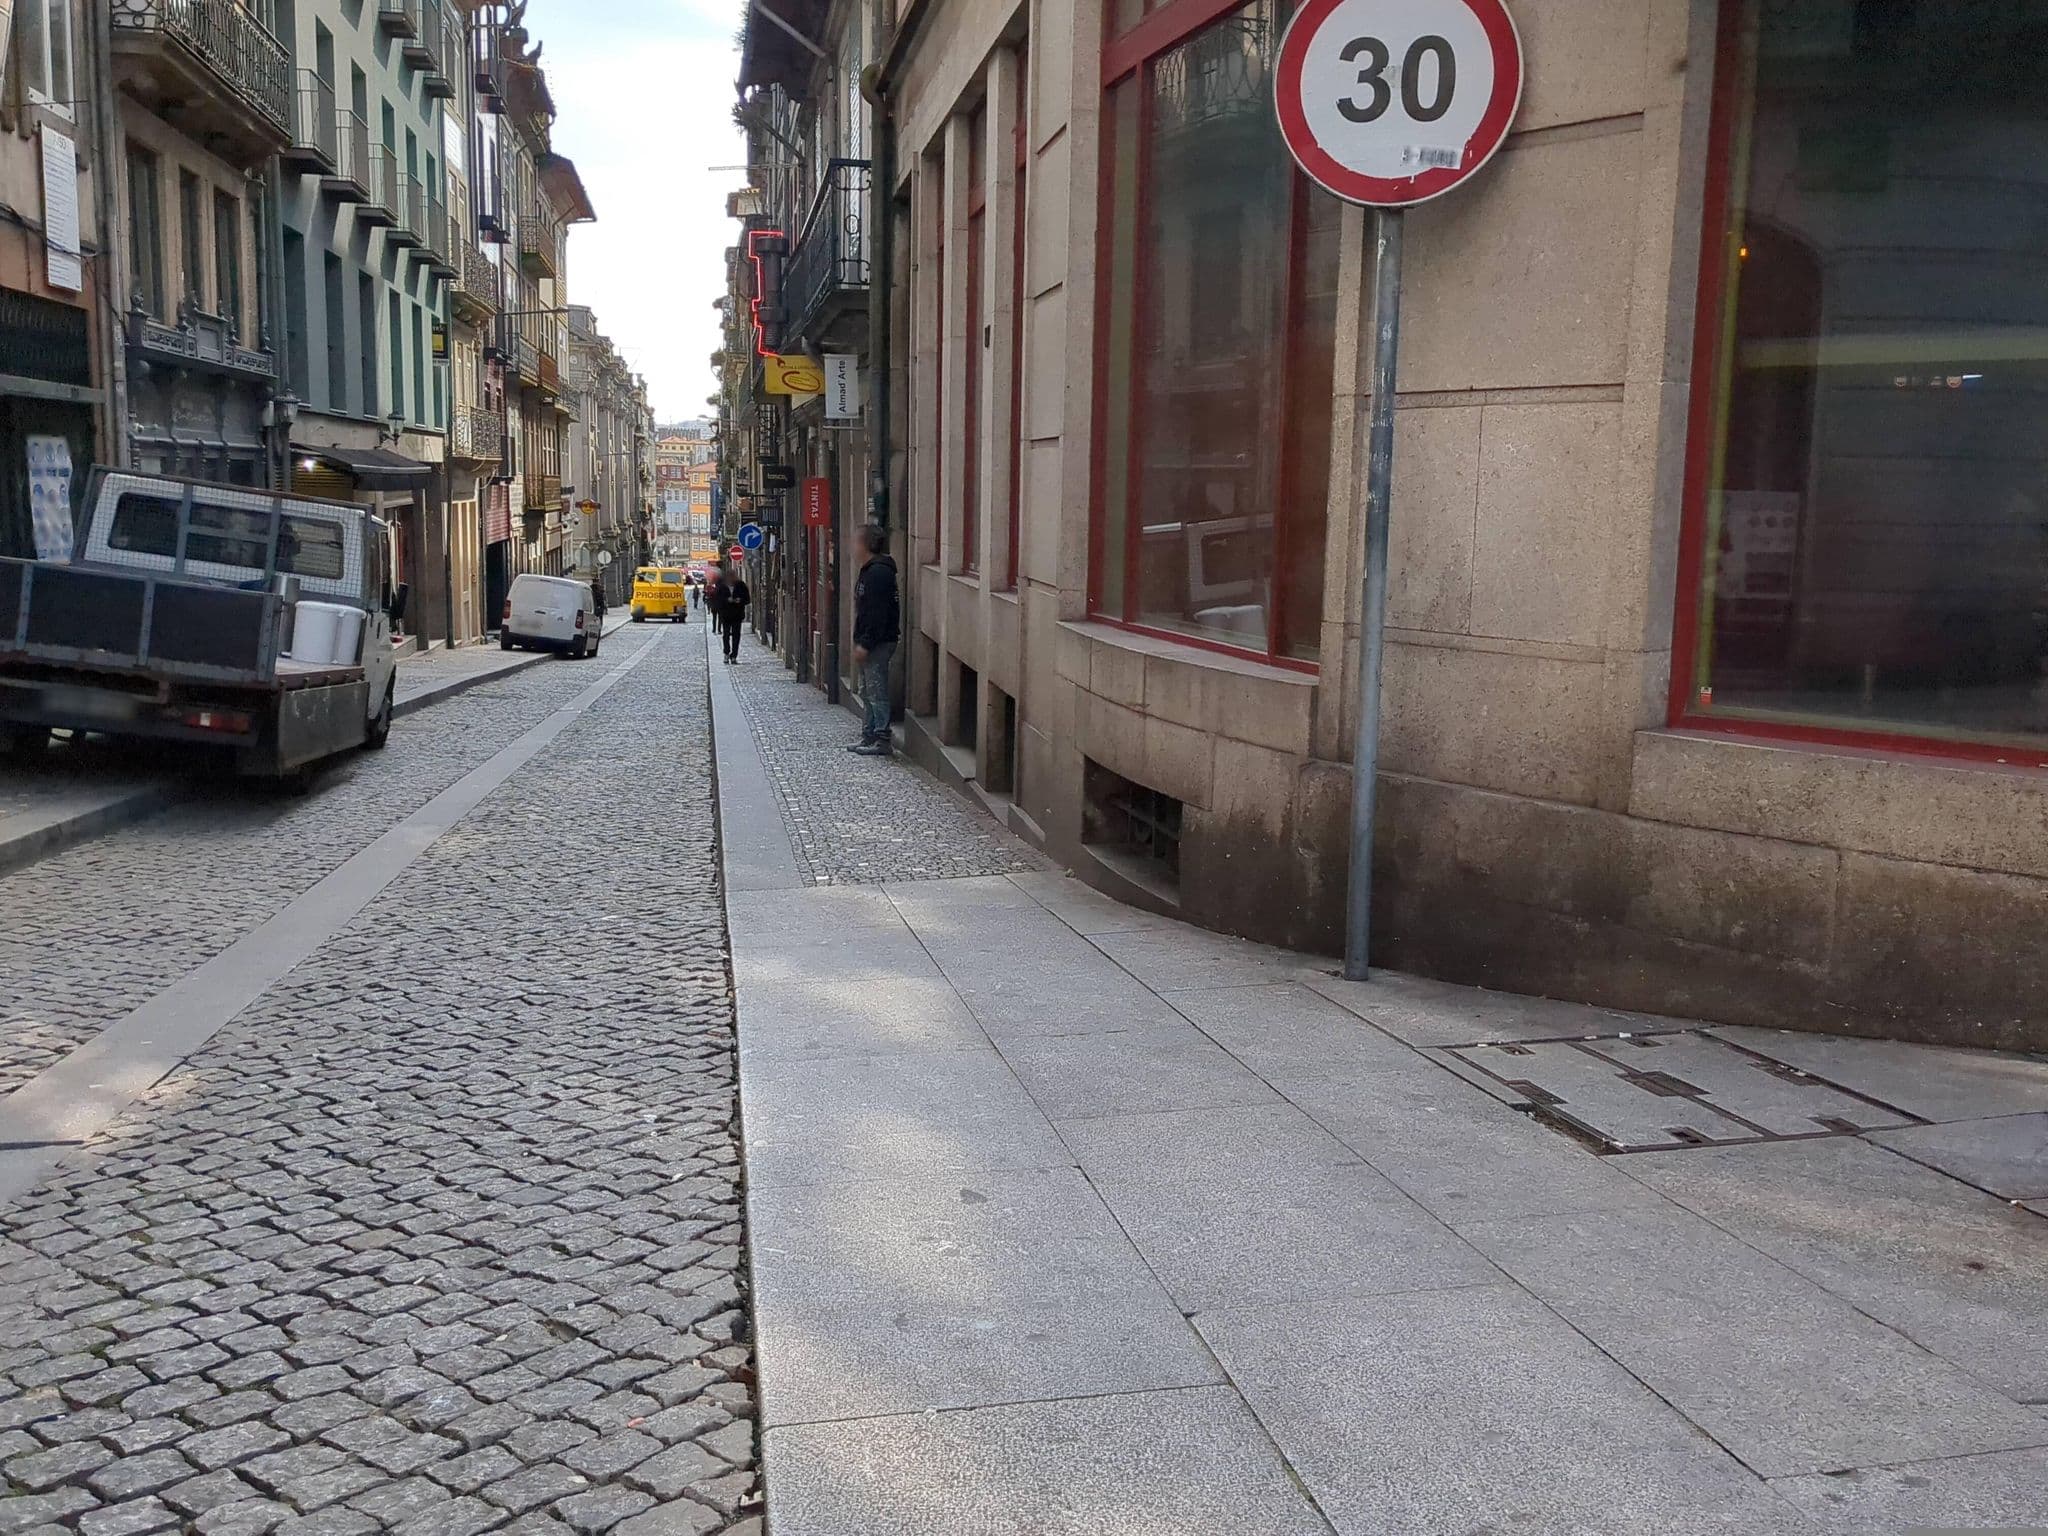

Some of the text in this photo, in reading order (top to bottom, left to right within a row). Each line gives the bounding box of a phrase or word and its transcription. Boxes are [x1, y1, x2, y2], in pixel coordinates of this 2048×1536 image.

[1336, 34, 1457, 123] 30
[810, 484, 819, 518] TINTAS
[636, 591, 682, 599] PROSEGUR
